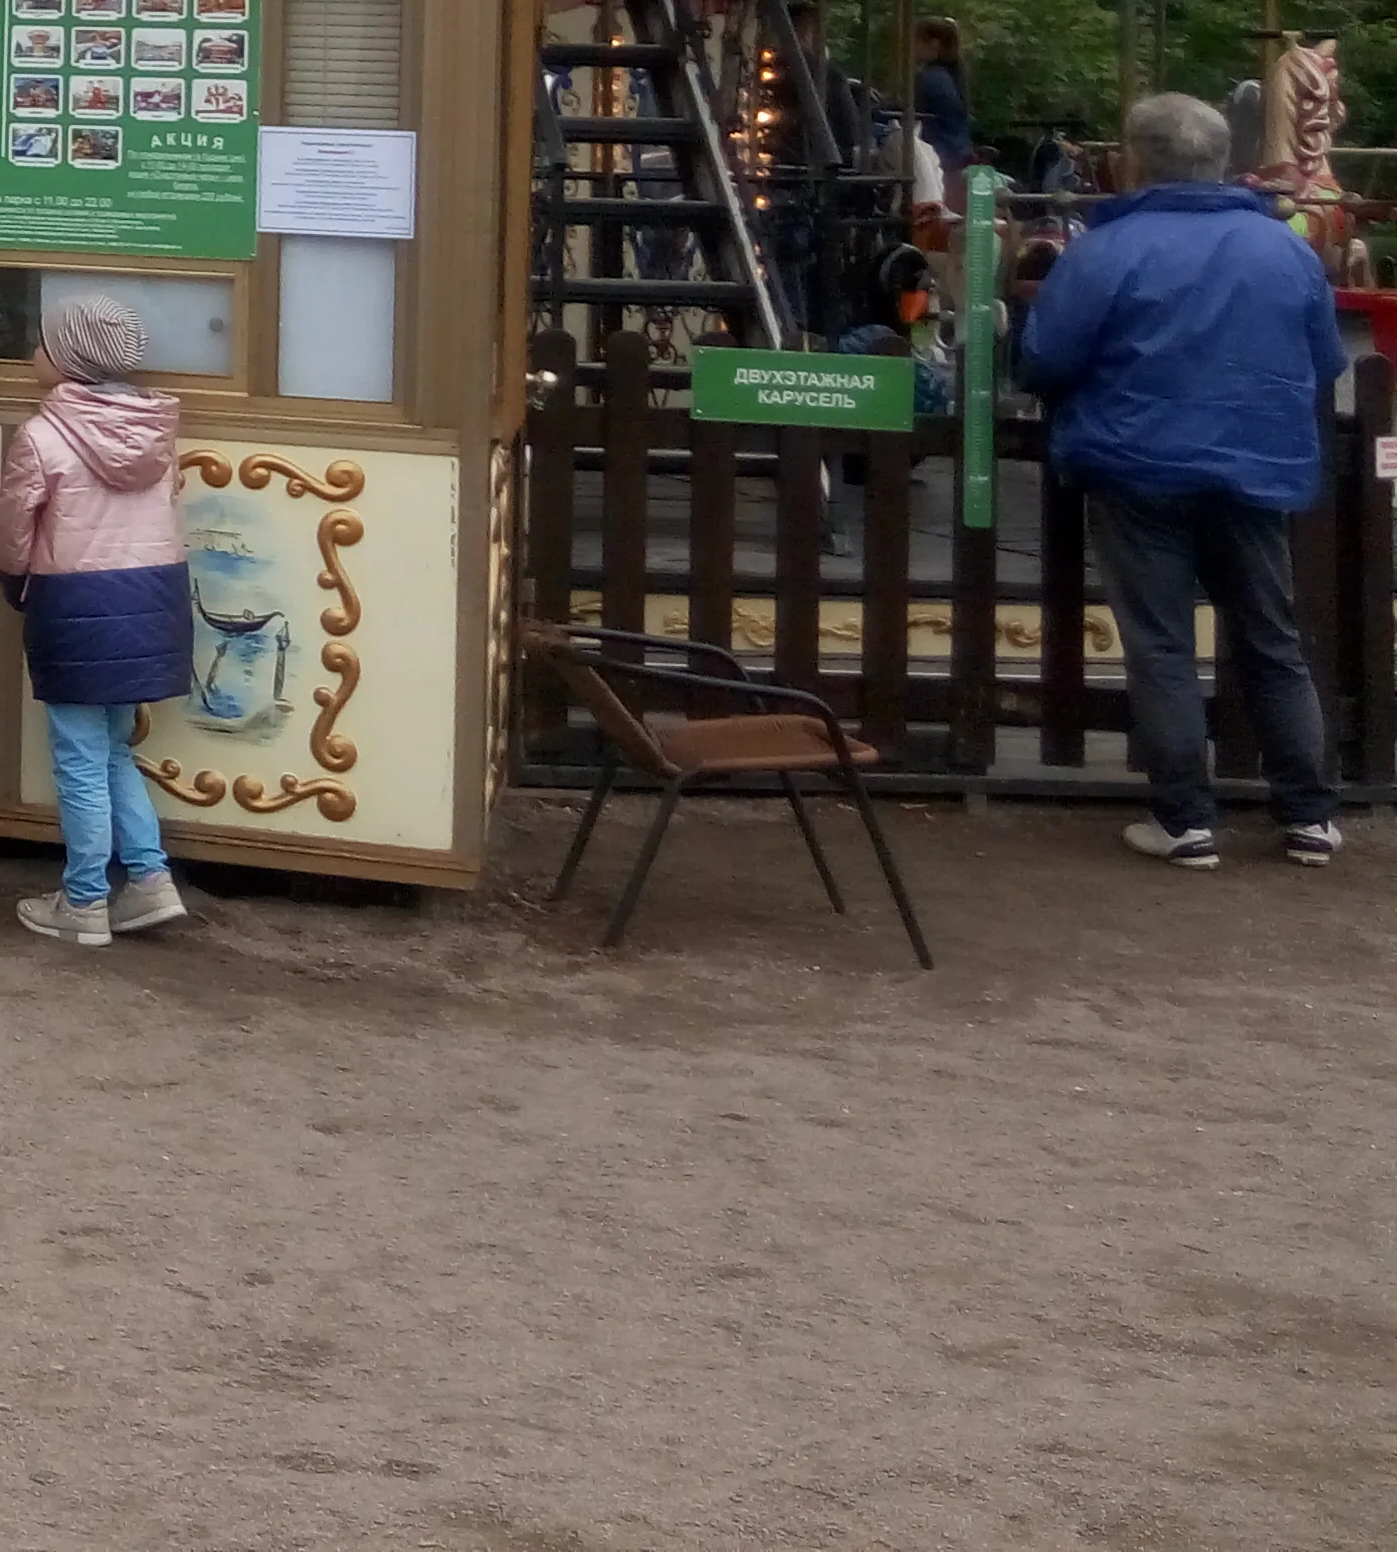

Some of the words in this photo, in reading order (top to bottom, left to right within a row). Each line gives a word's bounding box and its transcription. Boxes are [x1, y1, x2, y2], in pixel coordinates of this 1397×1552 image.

[150, 132, 224, 150] АКЦИЯ
[733, 367, 876, 390] ДВУХЭТАЖНАЯ
[757, 389, 857, 409] КАРУСЕЛЬ
